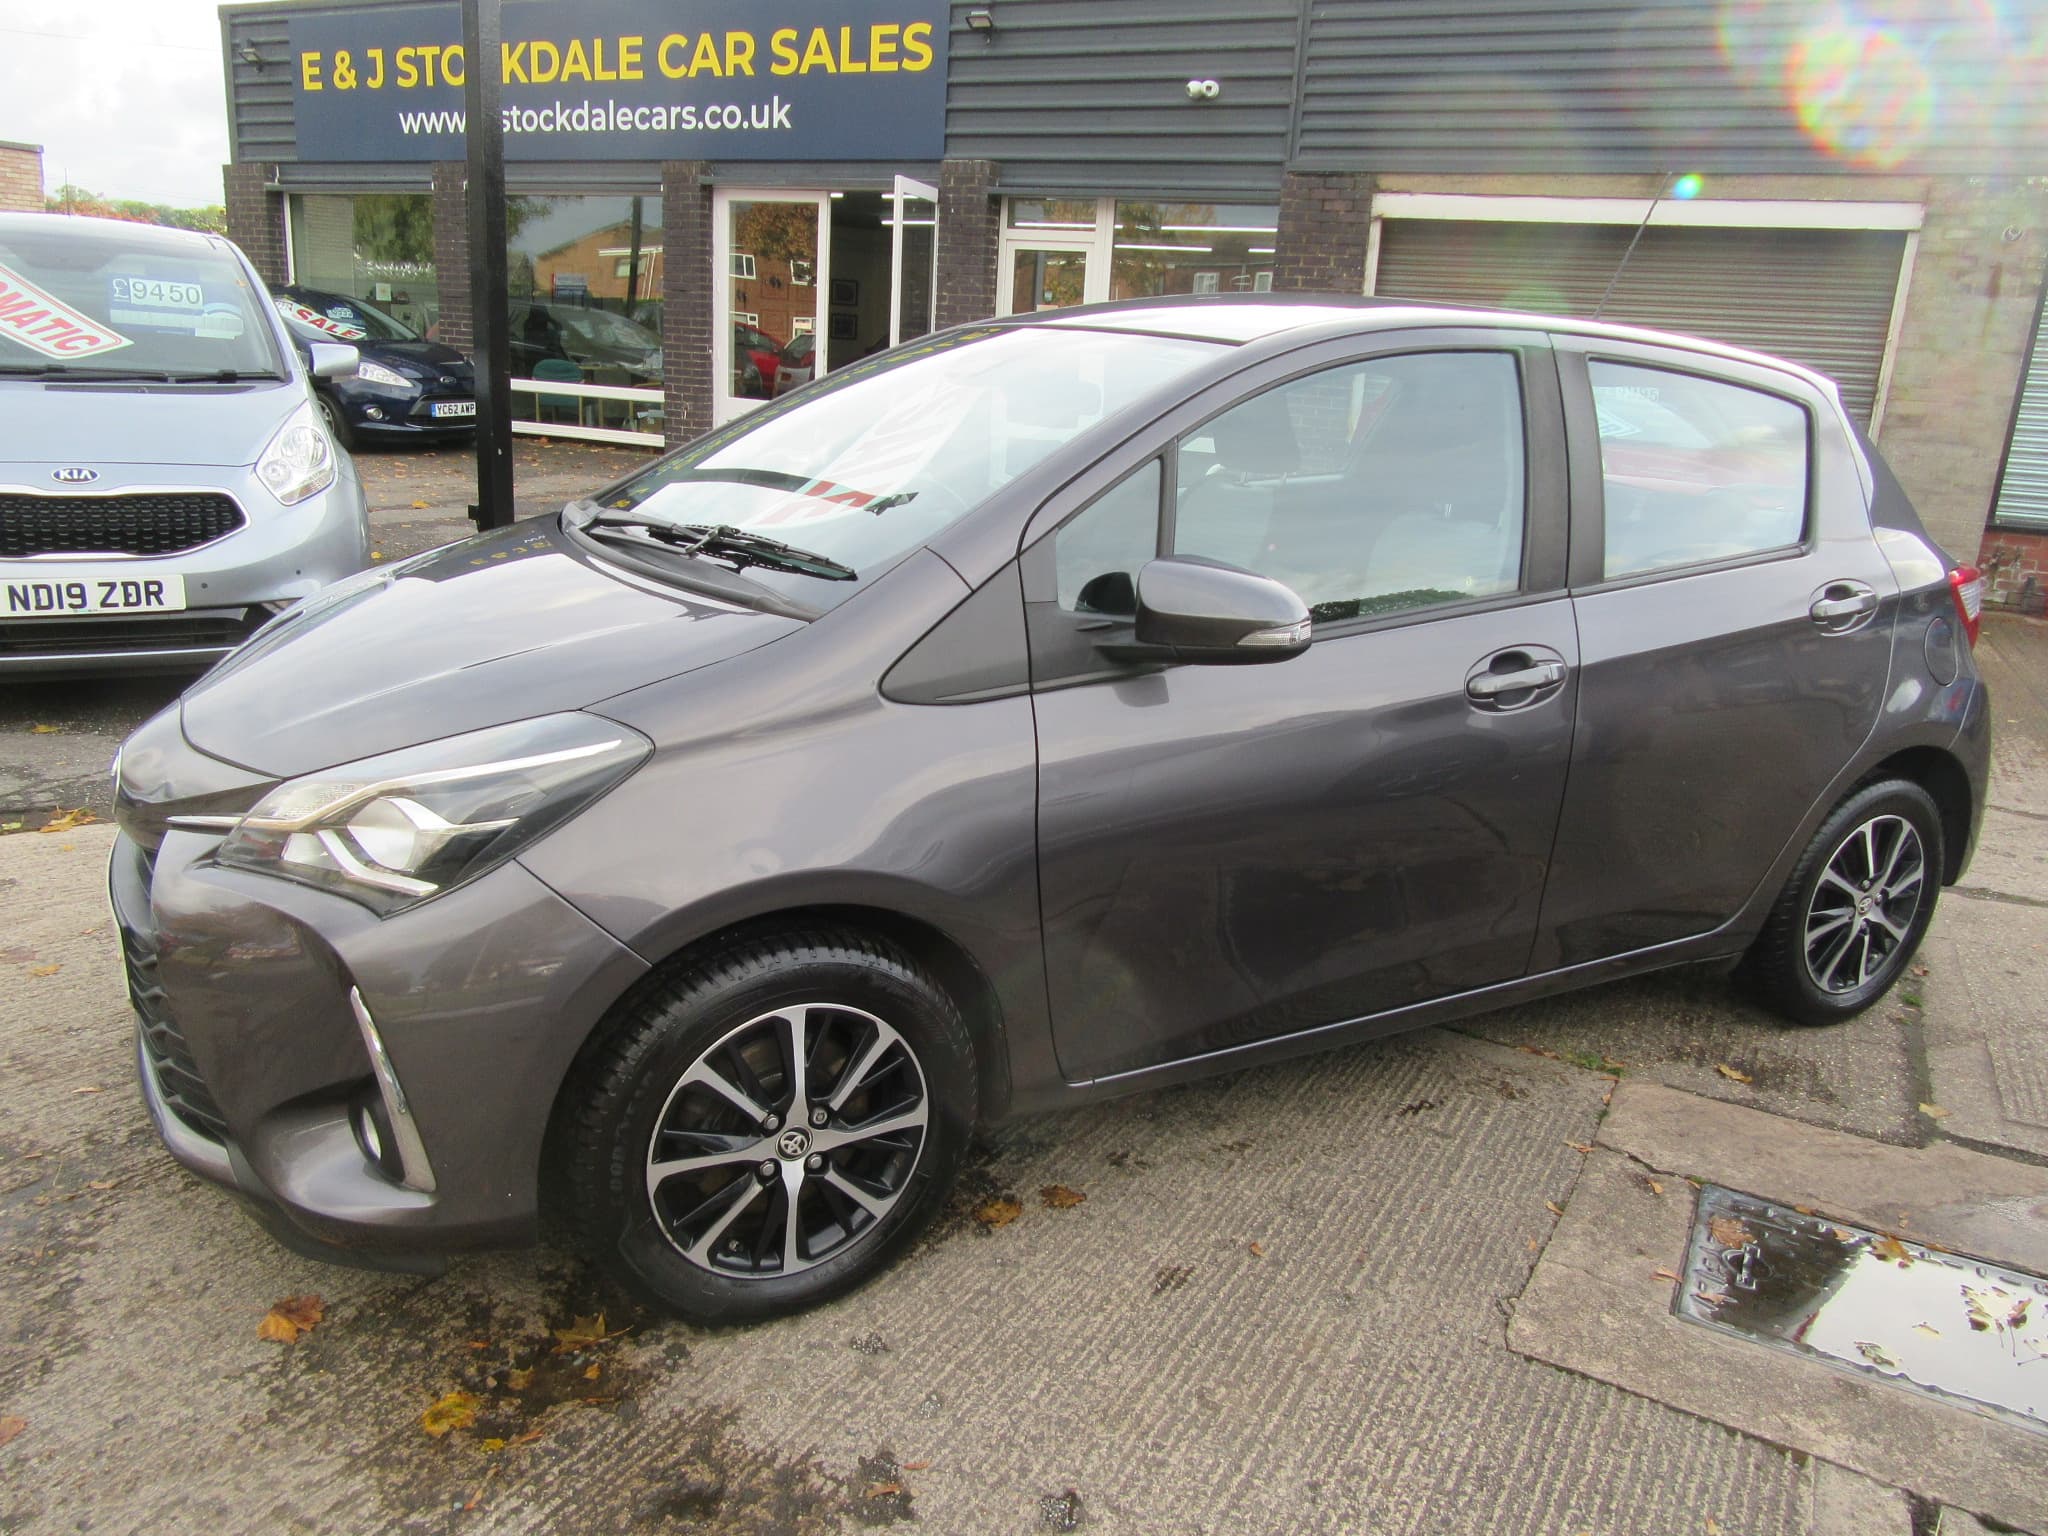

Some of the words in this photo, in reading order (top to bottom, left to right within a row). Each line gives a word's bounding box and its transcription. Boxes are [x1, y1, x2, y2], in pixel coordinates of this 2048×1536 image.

[301, 52, 323, 90] E
[333, 50, 357, 89] &
[366, 48, 384, 89] J
[396, 37, 644, 88] STOKDALE
[657, 33, 755, 79] CAR
[770, 22, 934, 75] SALES
[0, 281, 101, 350] MATIC
[293, 308, 361, 337] SALE
[437, 404, 459, 415] YC62
[60, 469, 93, 480] KIA
[7, 583, 87, 611] ND19
[98, 580, 164, 608] ZDR
